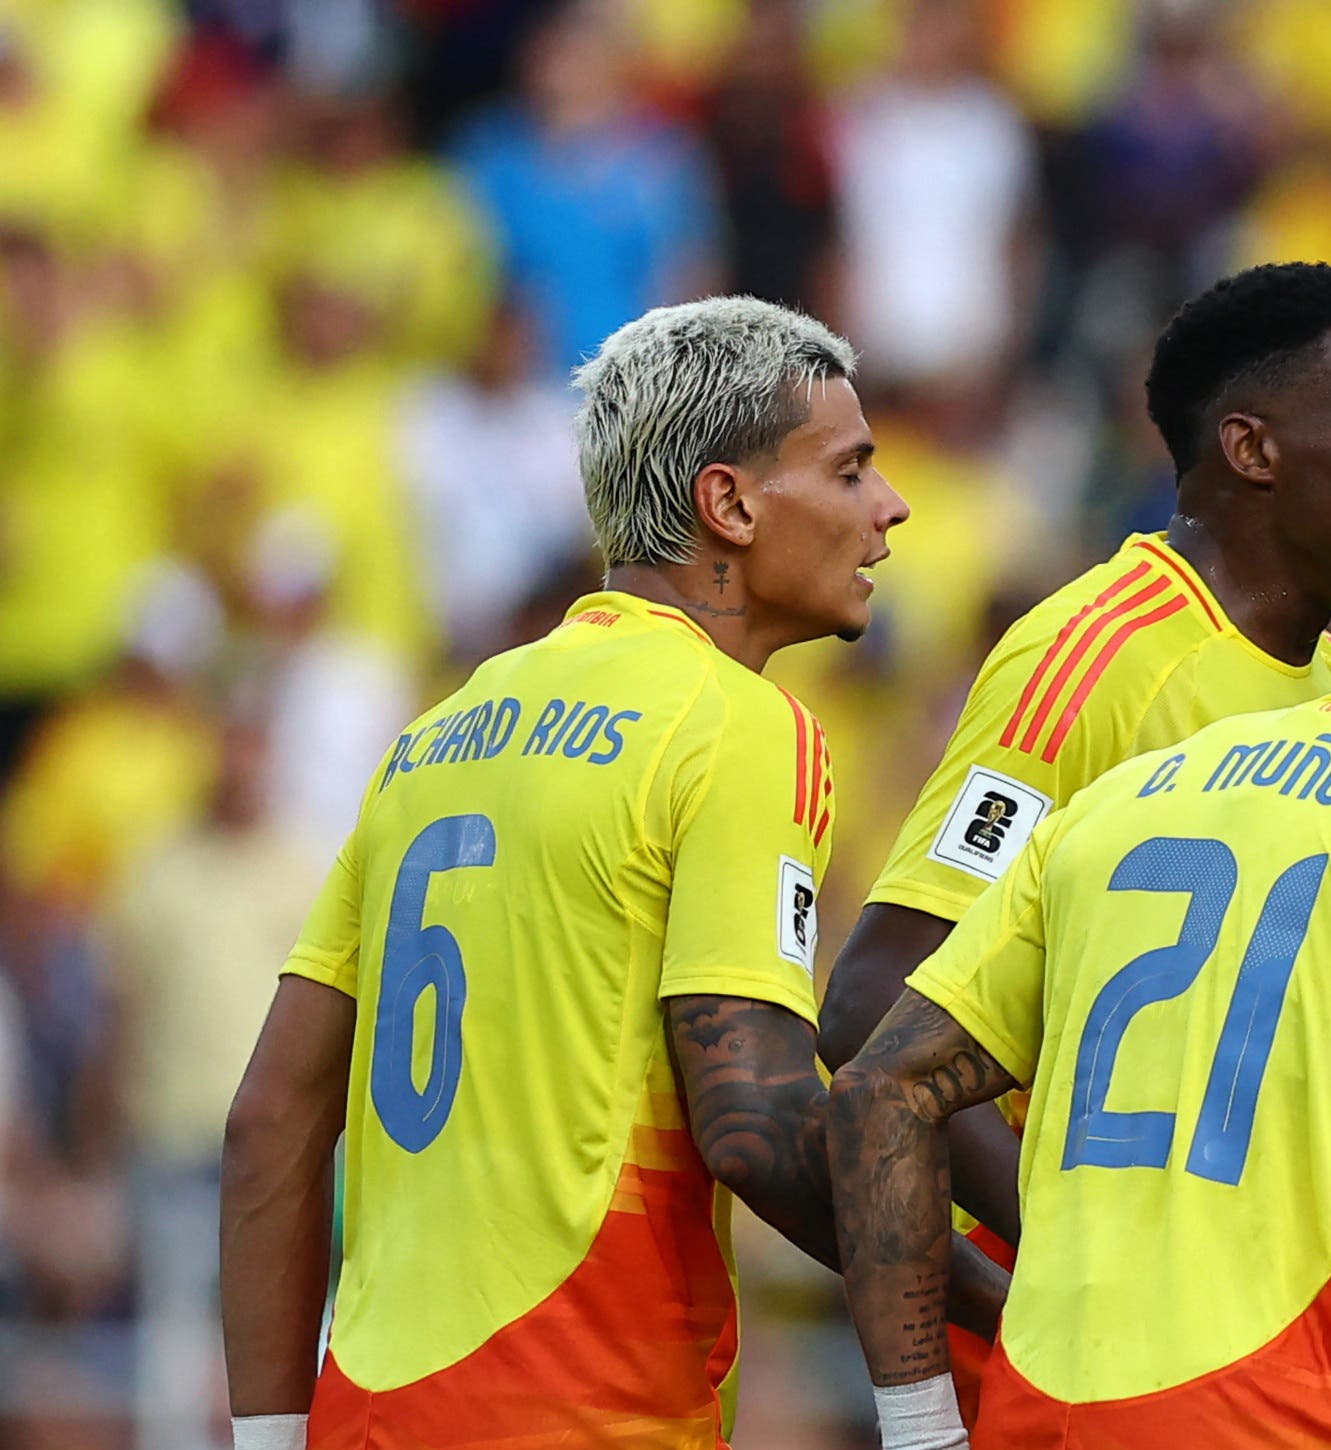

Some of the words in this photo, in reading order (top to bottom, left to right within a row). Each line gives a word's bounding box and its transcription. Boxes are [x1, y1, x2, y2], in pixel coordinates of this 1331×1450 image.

[377, 696, 521, 794] RCHARD
[521, 697, 643, 766] RIOS
[1135, 752, 1187, 799] D.
[369, 812, 497, 1155] 6
[1060, 835, 1330, 1187] 21
